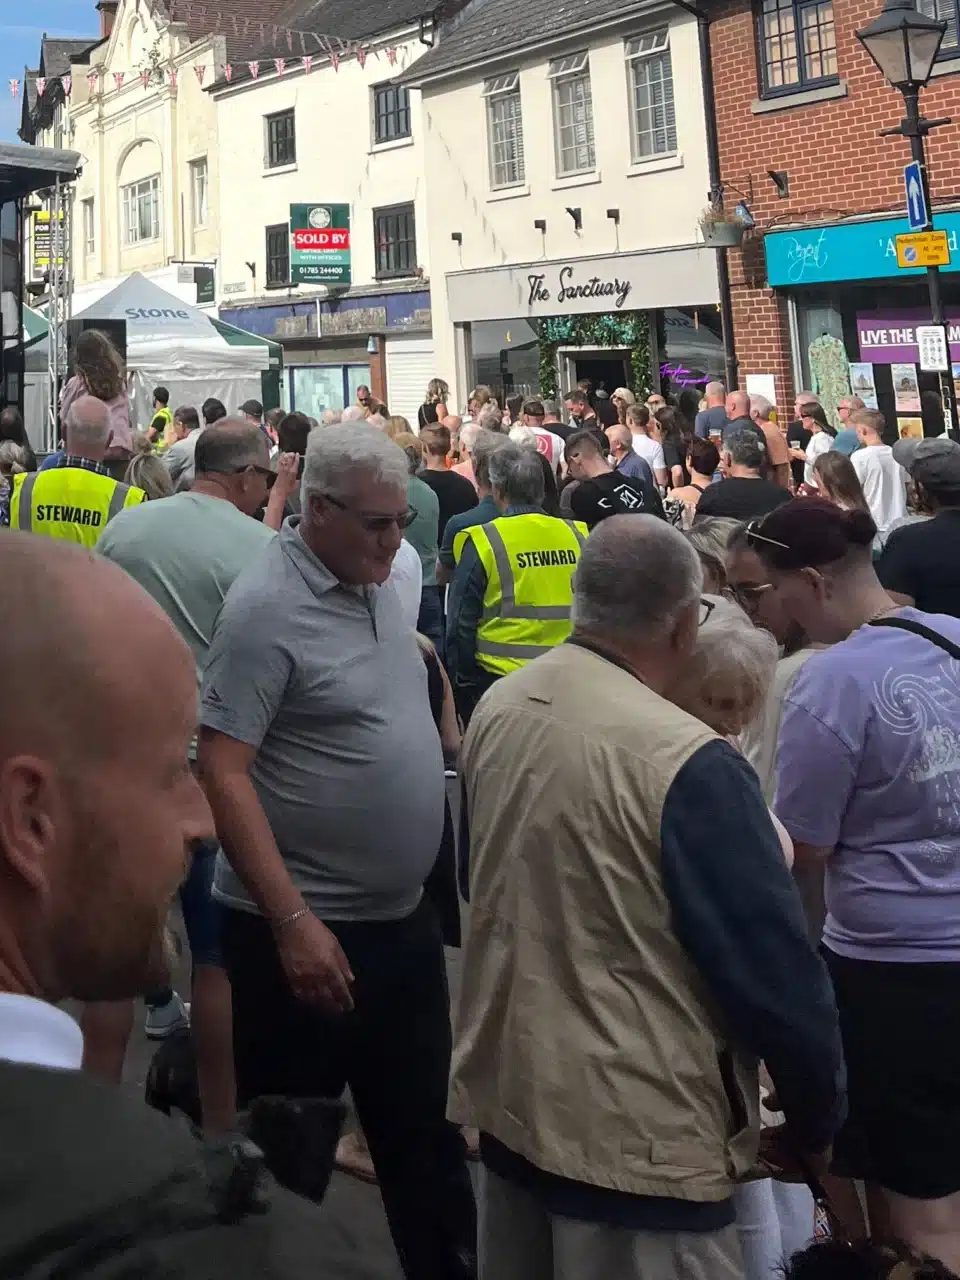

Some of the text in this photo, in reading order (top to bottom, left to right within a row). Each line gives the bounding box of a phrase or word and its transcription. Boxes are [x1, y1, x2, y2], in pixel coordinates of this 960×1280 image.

[296, 233, 347, 245] SOLD BY
[299, 266, 343, 274] 01785 244400
[527, 266, 632, 308] The Sanctuary
[124, 307, 190, 320] Stone
[860, 329, 888, 345] LIVE
[888, 327, 914, 343] THE
[36, 504, 102, 527] STEWARD
[515, 549, 577, 569] STEWARD
